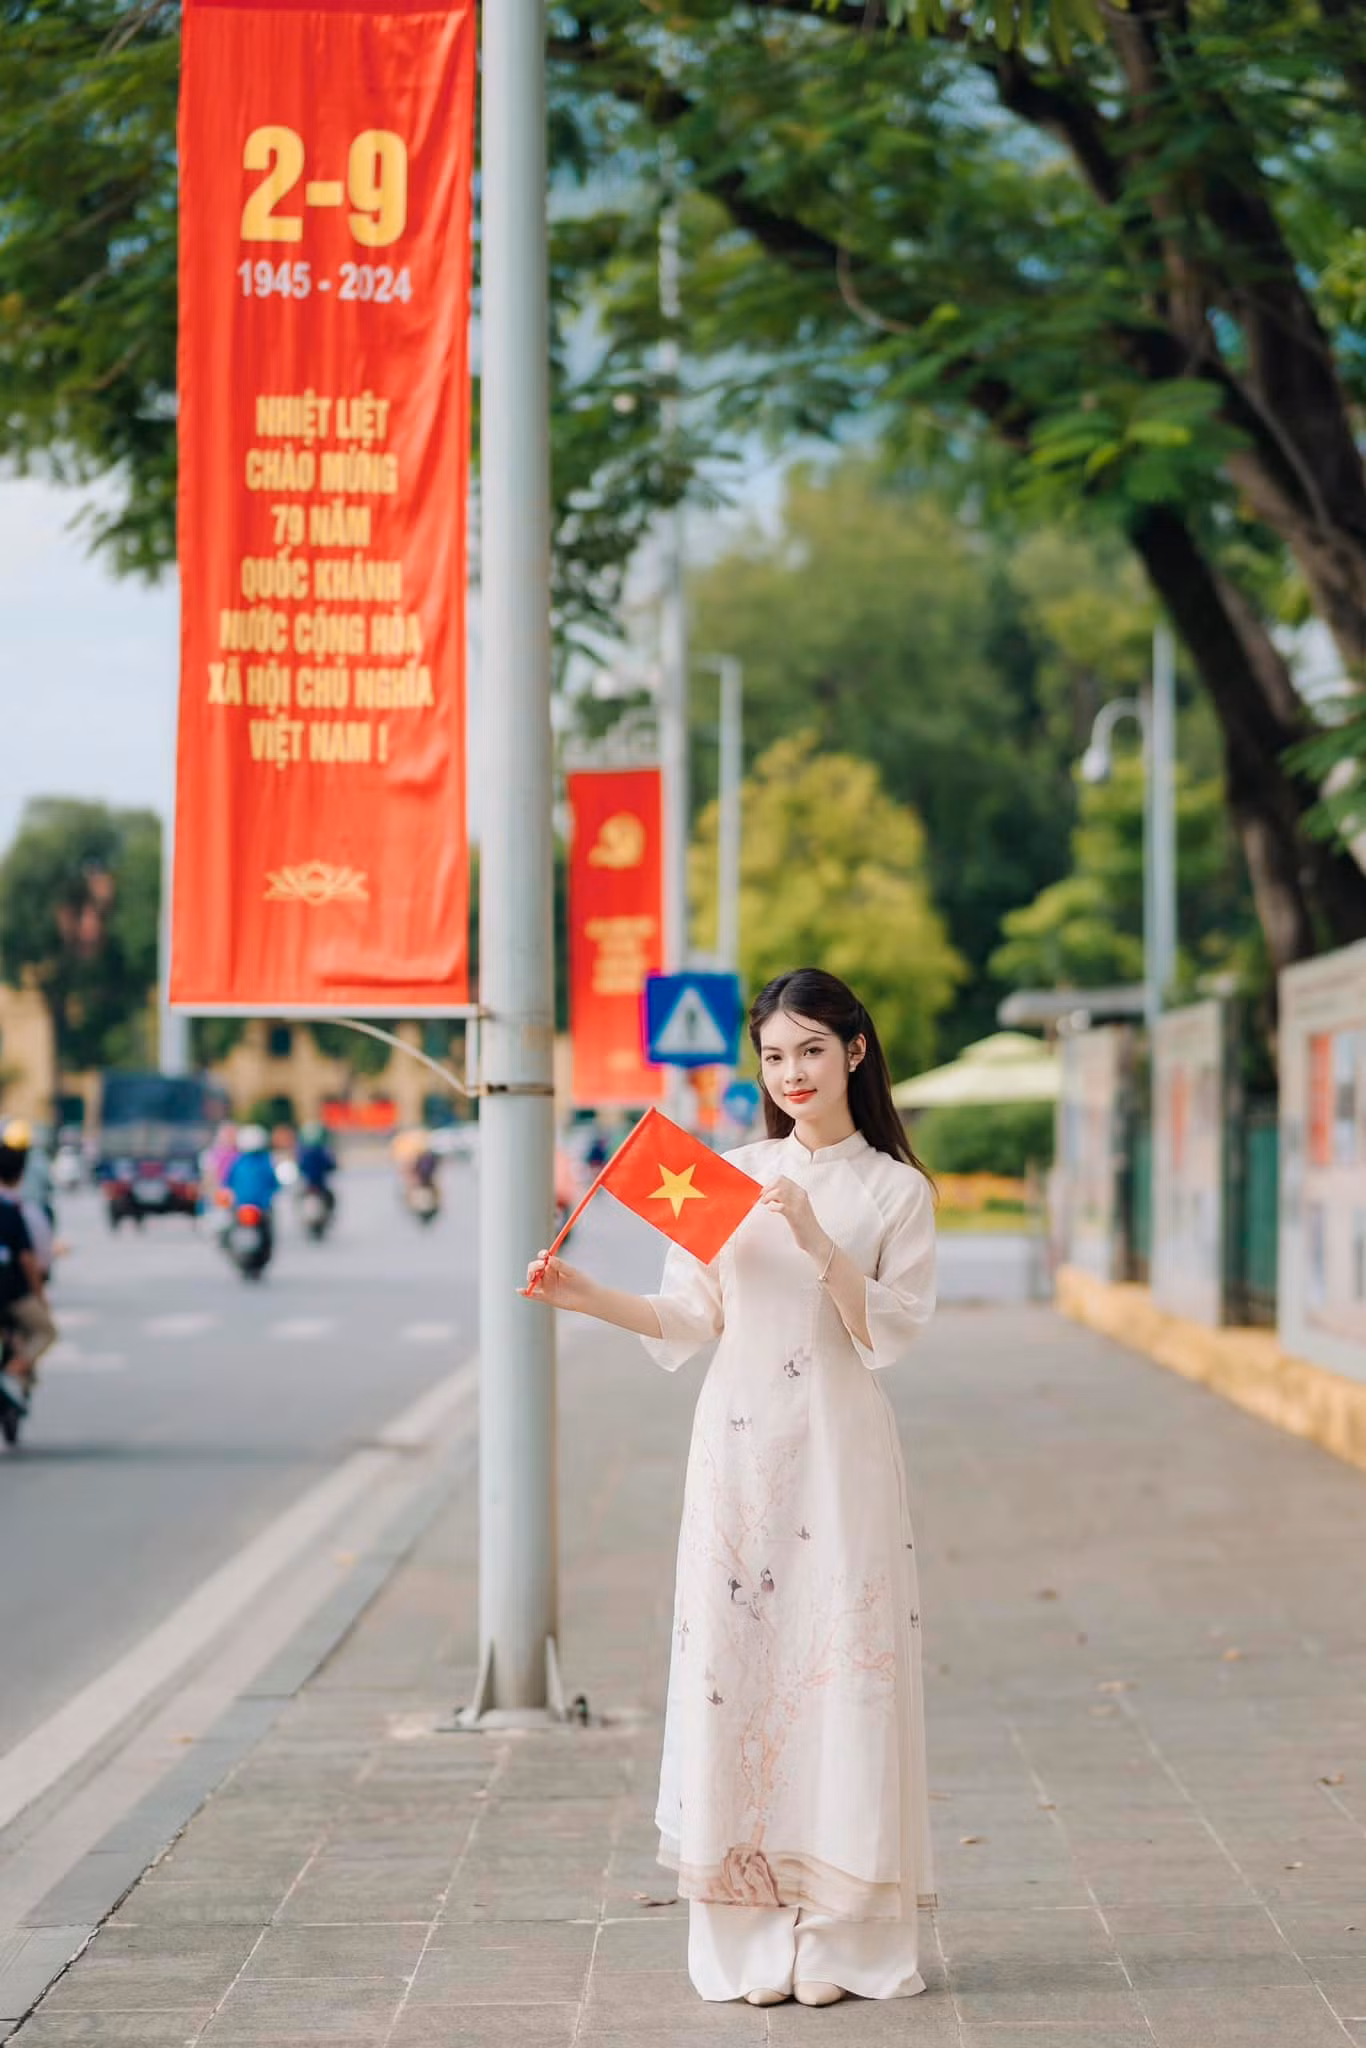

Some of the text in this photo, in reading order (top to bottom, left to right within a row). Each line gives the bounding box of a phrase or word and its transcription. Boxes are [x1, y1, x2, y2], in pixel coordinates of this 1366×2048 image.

[240, 125, 408, 247] 2-9
[237, 259, 412, 303] 1945 - 2024
[256, 388, 391, 448] NHIỆT LIỆT
[245, 443, 316, 492] CHÀO
[271, 504, 305, 546] 79
[241, 546, 402, 602] QUỐC KHÁNH
[294, 605, 366, 663] CỘNG
[246, 659, 291, 716] HỘI
[250, 712, 304, 770] VIỆT
[309, 721, 371, 763] NAM
